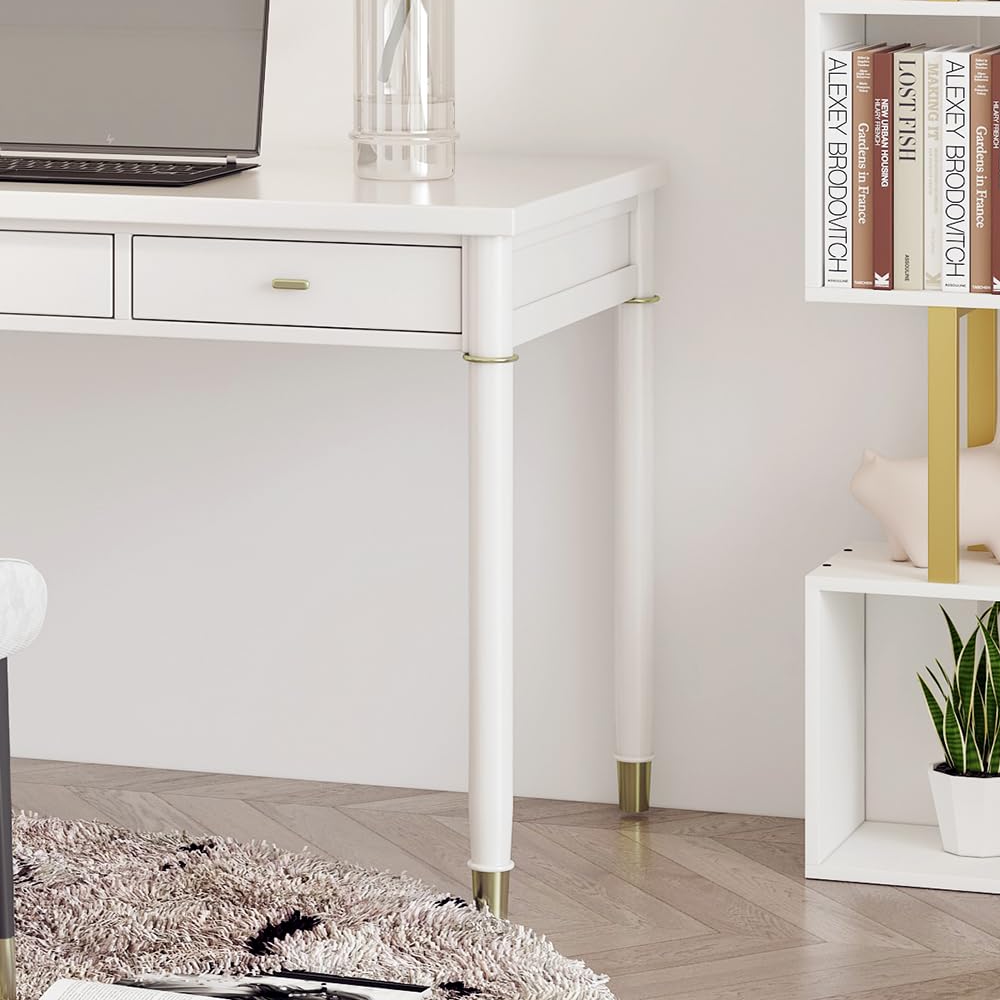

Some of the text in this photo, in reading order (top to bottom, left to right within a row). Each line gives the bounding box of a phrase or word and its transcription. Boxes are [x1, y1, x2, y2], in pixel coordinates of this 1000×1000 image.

[881, 98, 889, 187] NEW URBAN HOUSING
[898, 61, 917, 160] LOST FISH
[927, 64, 940, 121] MAKING
[828, 57, 848, 273] ALEXEY BRODOVITCH
[857, 122, 870, 225] Gardens in France
[944, 60, 966, 277] ALEXEY BRODOVITCH
[975, 125, 988, 229] Gardens in France
